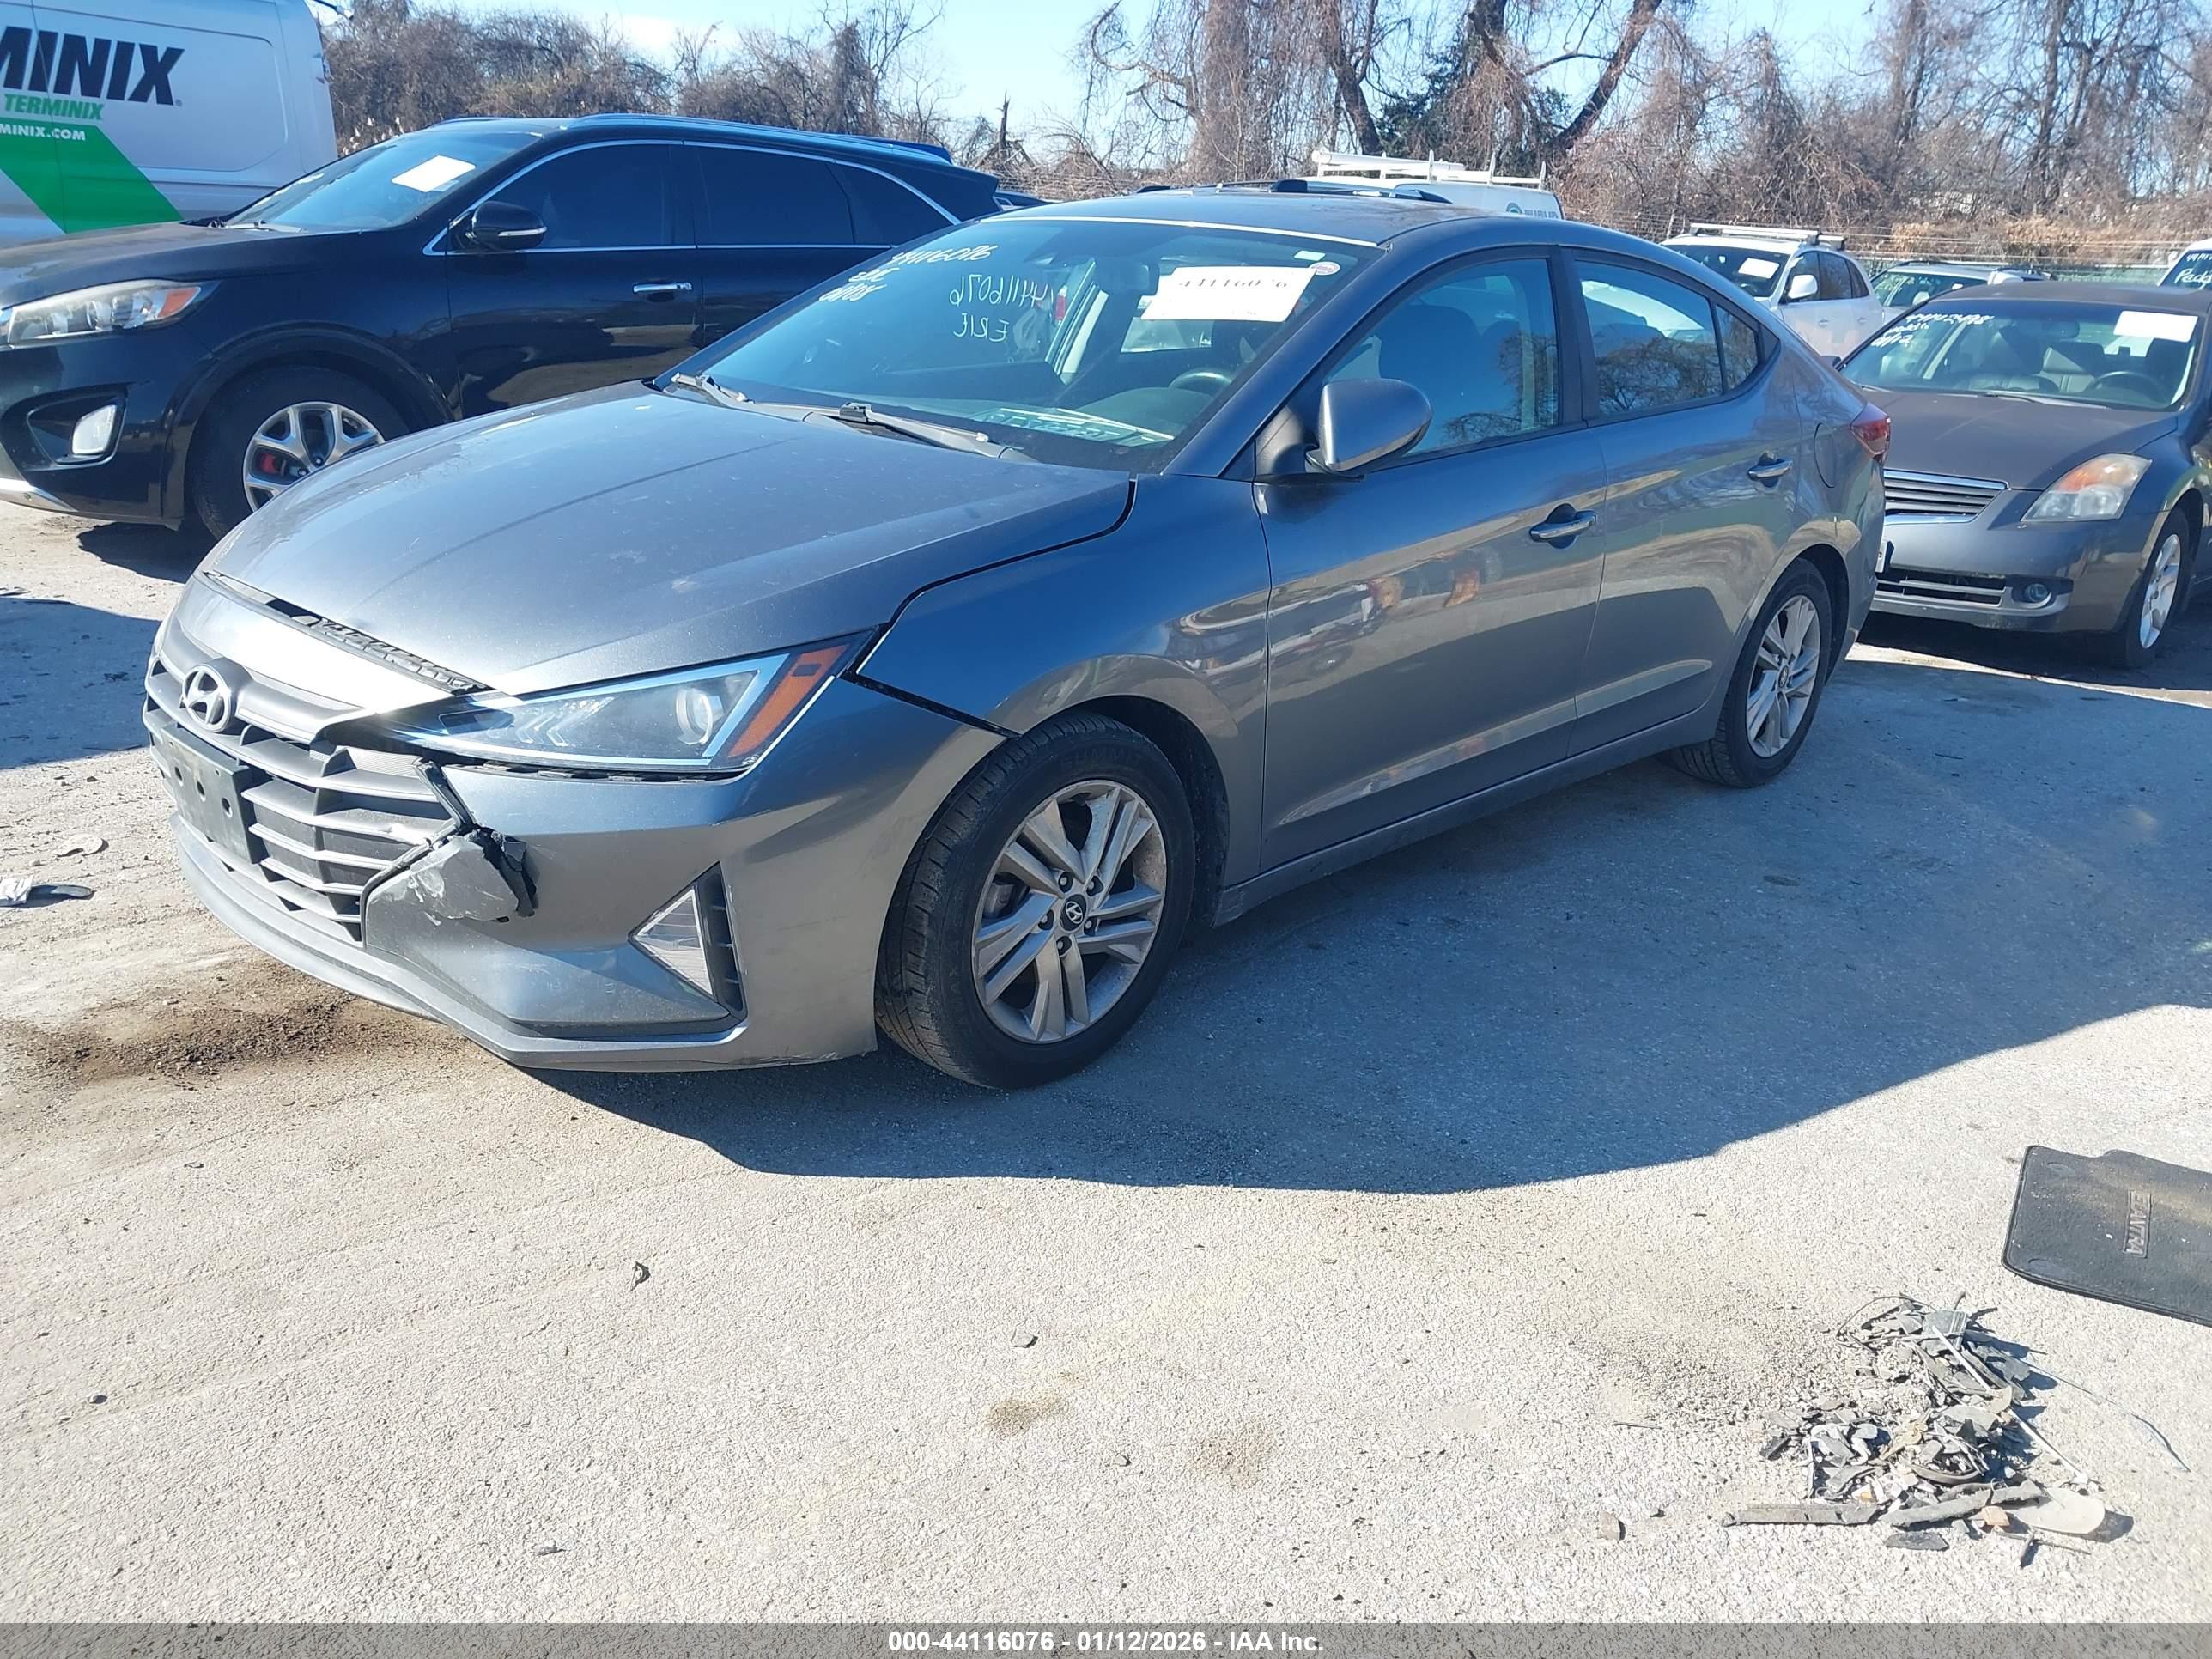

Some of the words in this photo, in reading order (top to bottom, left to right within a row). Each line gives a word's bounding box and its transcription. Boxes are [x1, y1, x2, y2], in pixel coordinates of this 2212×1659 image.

[4, 94, 104, 120] TERMINIX
[887, 244, 998, 265] 44116076
[2125, 1194, 2148, 1255] ELANTRA
